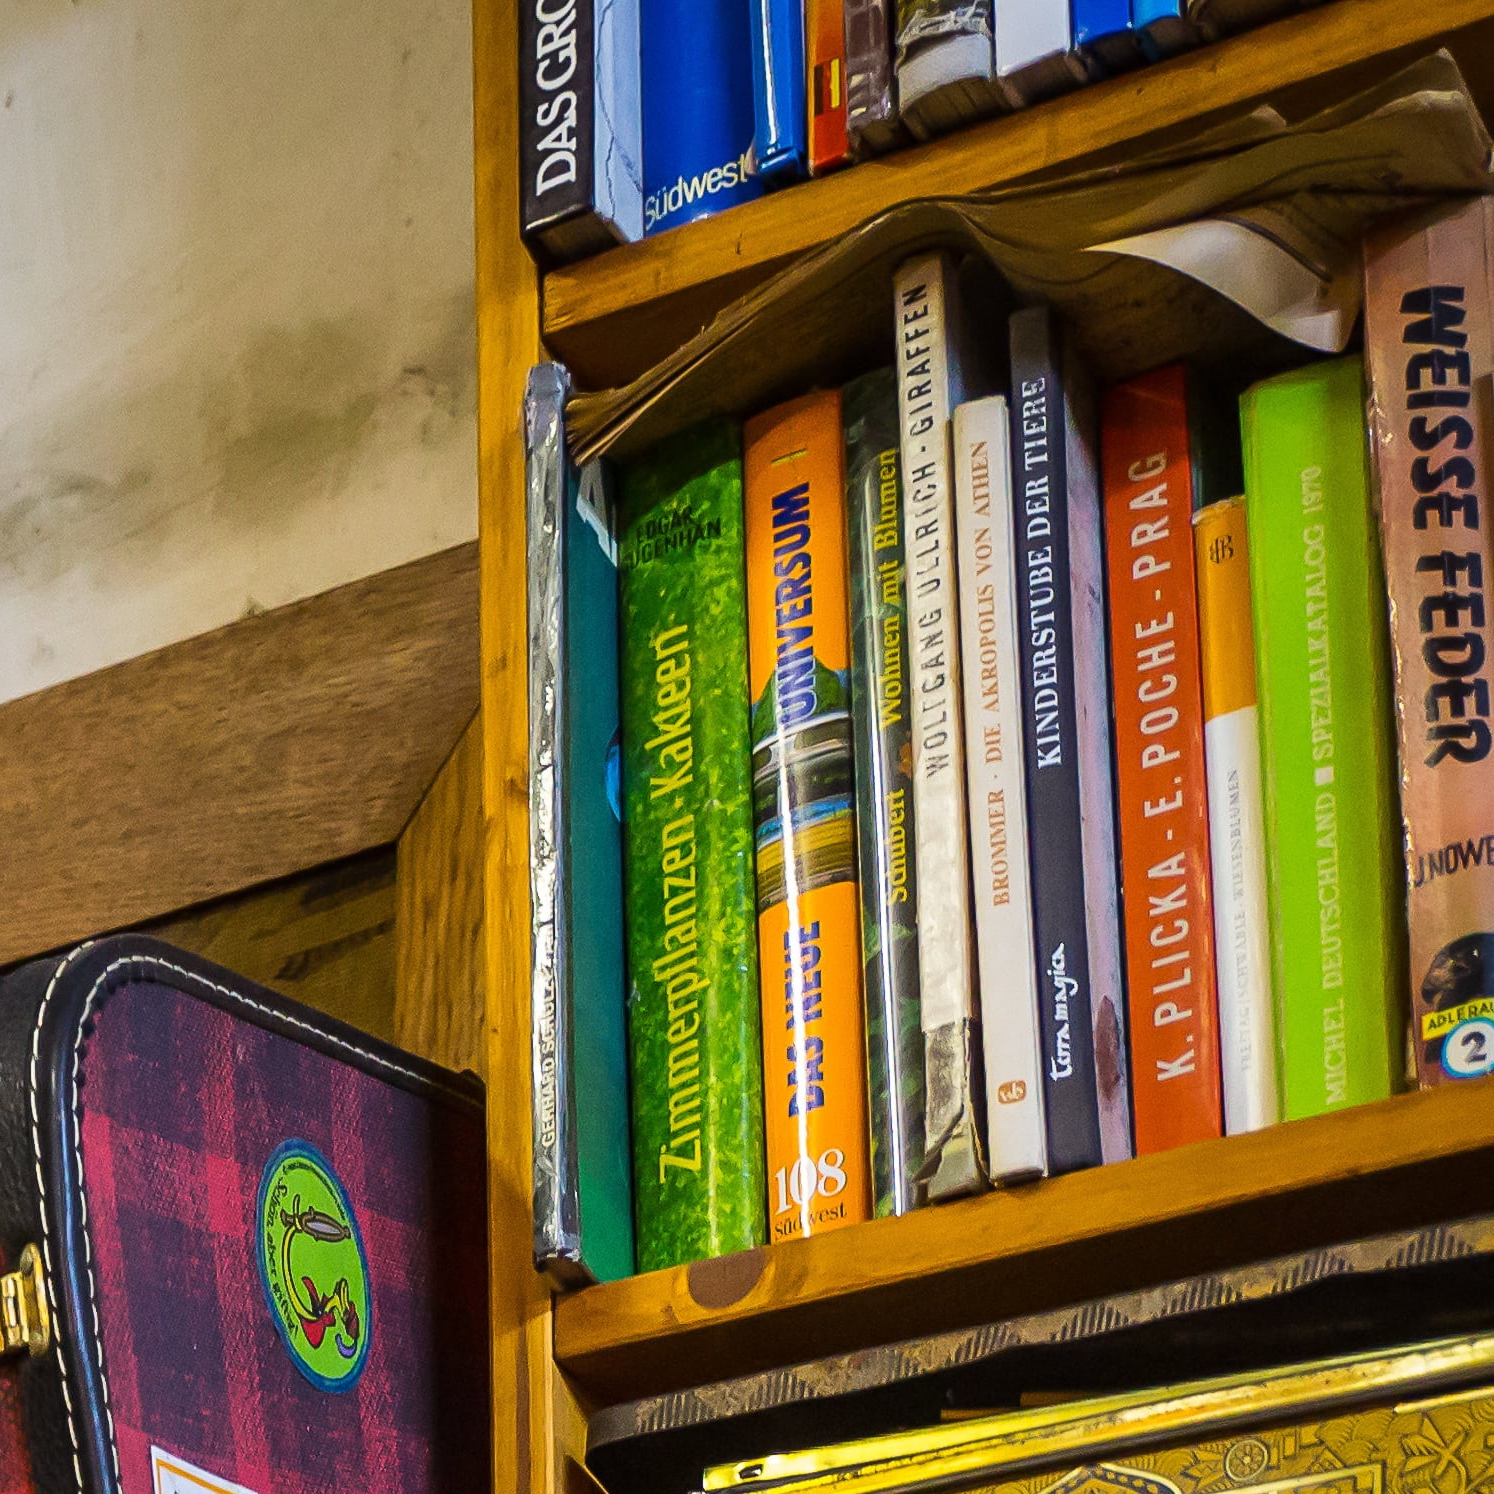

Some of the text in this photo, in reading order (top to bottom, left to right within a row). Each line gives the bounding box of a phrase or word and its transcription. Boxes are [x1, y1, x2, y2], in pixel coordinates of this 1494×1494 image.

[536, 91, 577, 197] DAS
[644, 154, 749, 231] Südwest
[903, 283, 951, 779] WOLFGANG ULLRICH GIRAFFEN
[1021, 377, 1063, 769] KINDERSTUBE DER TIERE
[1400, 284, 1494, 769] WEISSE FEDER
[873, 449, 909, 903] Schubert Wohnen mit Blumen
[969, 441, 1010, 906] BROMMER DIE AKROPOLIS VON ATHEN
[1302, 523, 1336, 761] SPEZIALKATALOG
[771, 481, 826, 1120] DAS NEUE UNIVERSUM
[1127, 452, 1197, 1082] K. PLICKA E. POCHE PRAG
[1227, 767, 1246, 901] WIESENBLUMEN
[1047, 943, 1079, 1021] magica
[1314, 792, 1344, 990] DEUTSCHLAND
[1323, 997, 1348, 1106] MICHEL
[1460, 1031, 1488, 1064] 2
[774, 1149, 848, 1215] 108
